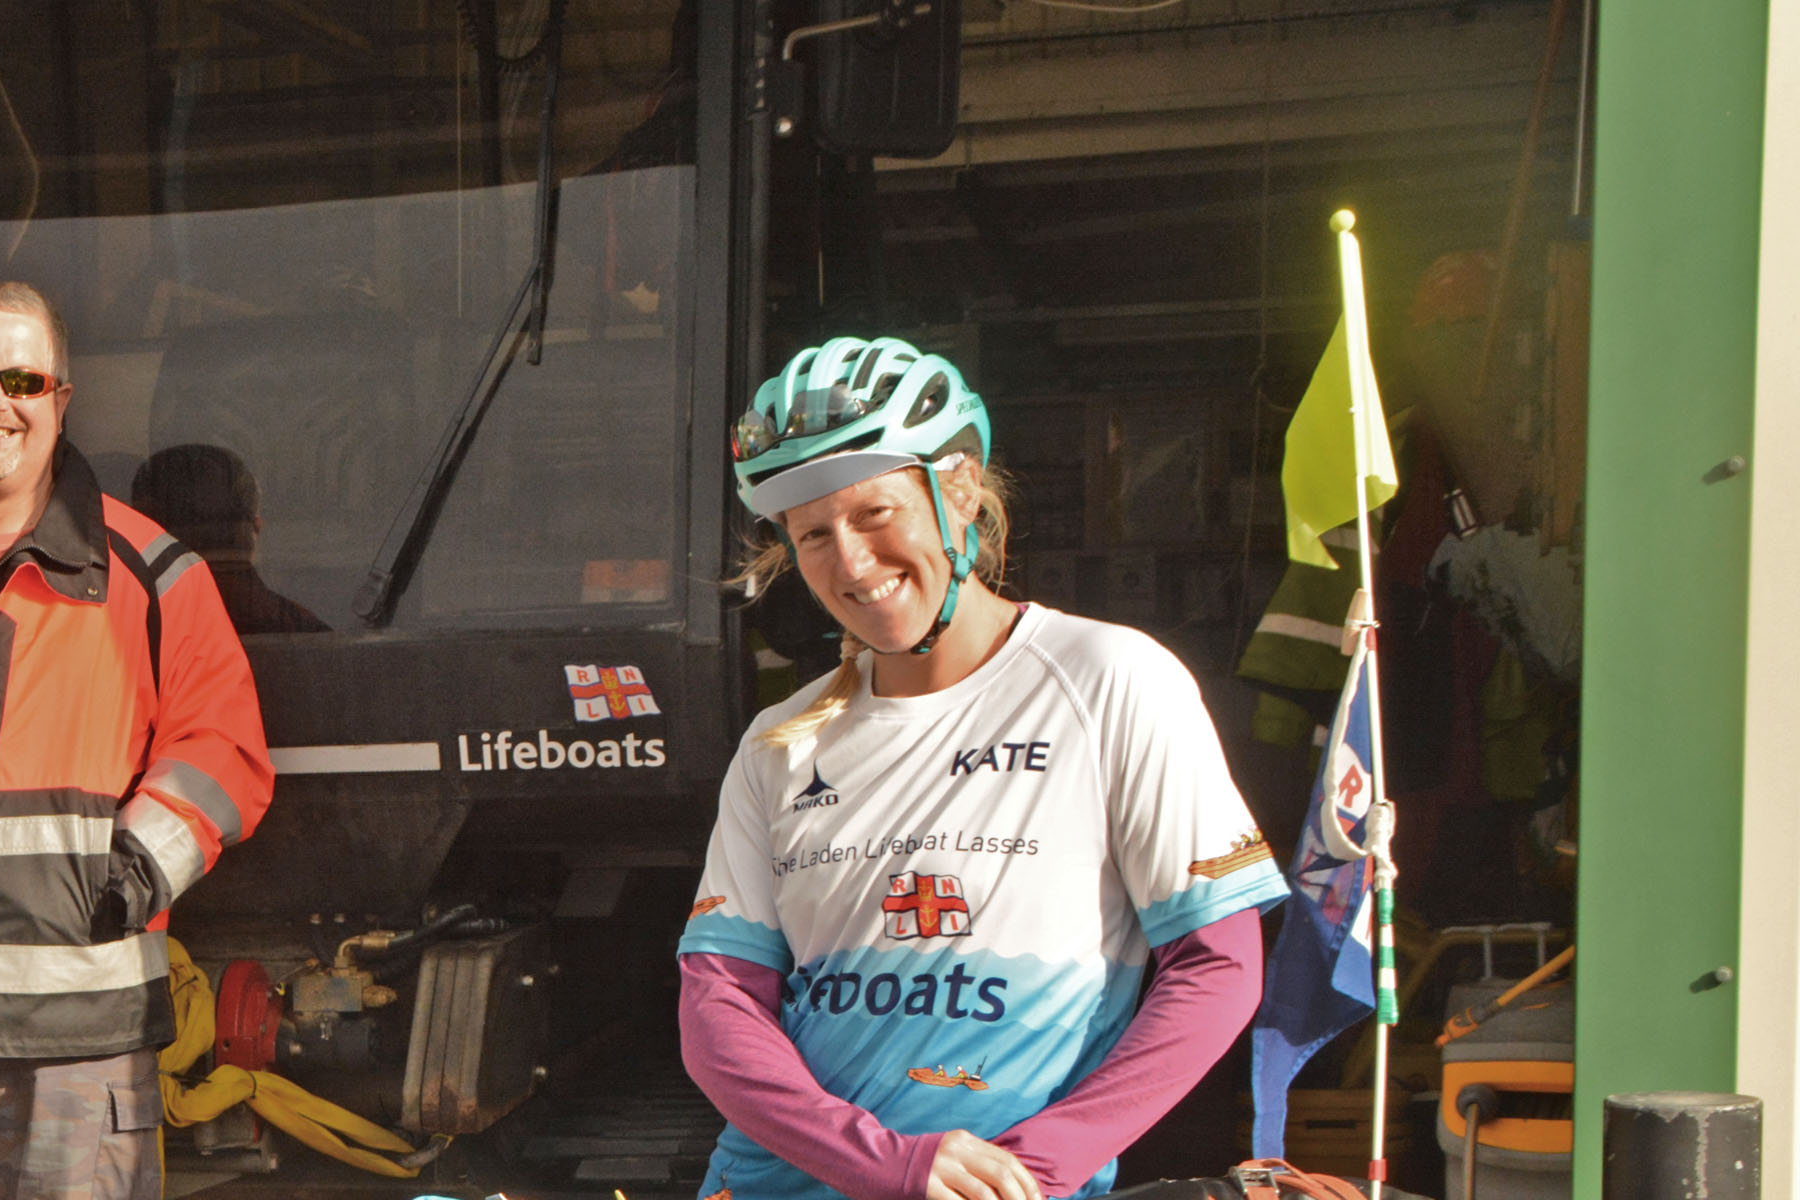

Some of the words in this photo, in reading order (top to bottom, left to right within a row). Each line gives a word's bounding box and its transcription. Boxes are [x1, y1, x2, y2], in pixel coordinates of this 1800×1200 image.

[577, 670, 590, 682] R
[624, 669, 637, 681] N
[587, 702, 600, 718] L
[458, 729, 666, 771] Lifeboats
[950, 741, 1050, 776] KATE
[801, 843, 856, 870] Laden
[955, 831, 1039, 856] Lasses
[892, 879, 906, 894] R
[942, 879, 955, 894] N
[896, 916, 906, 934] L
